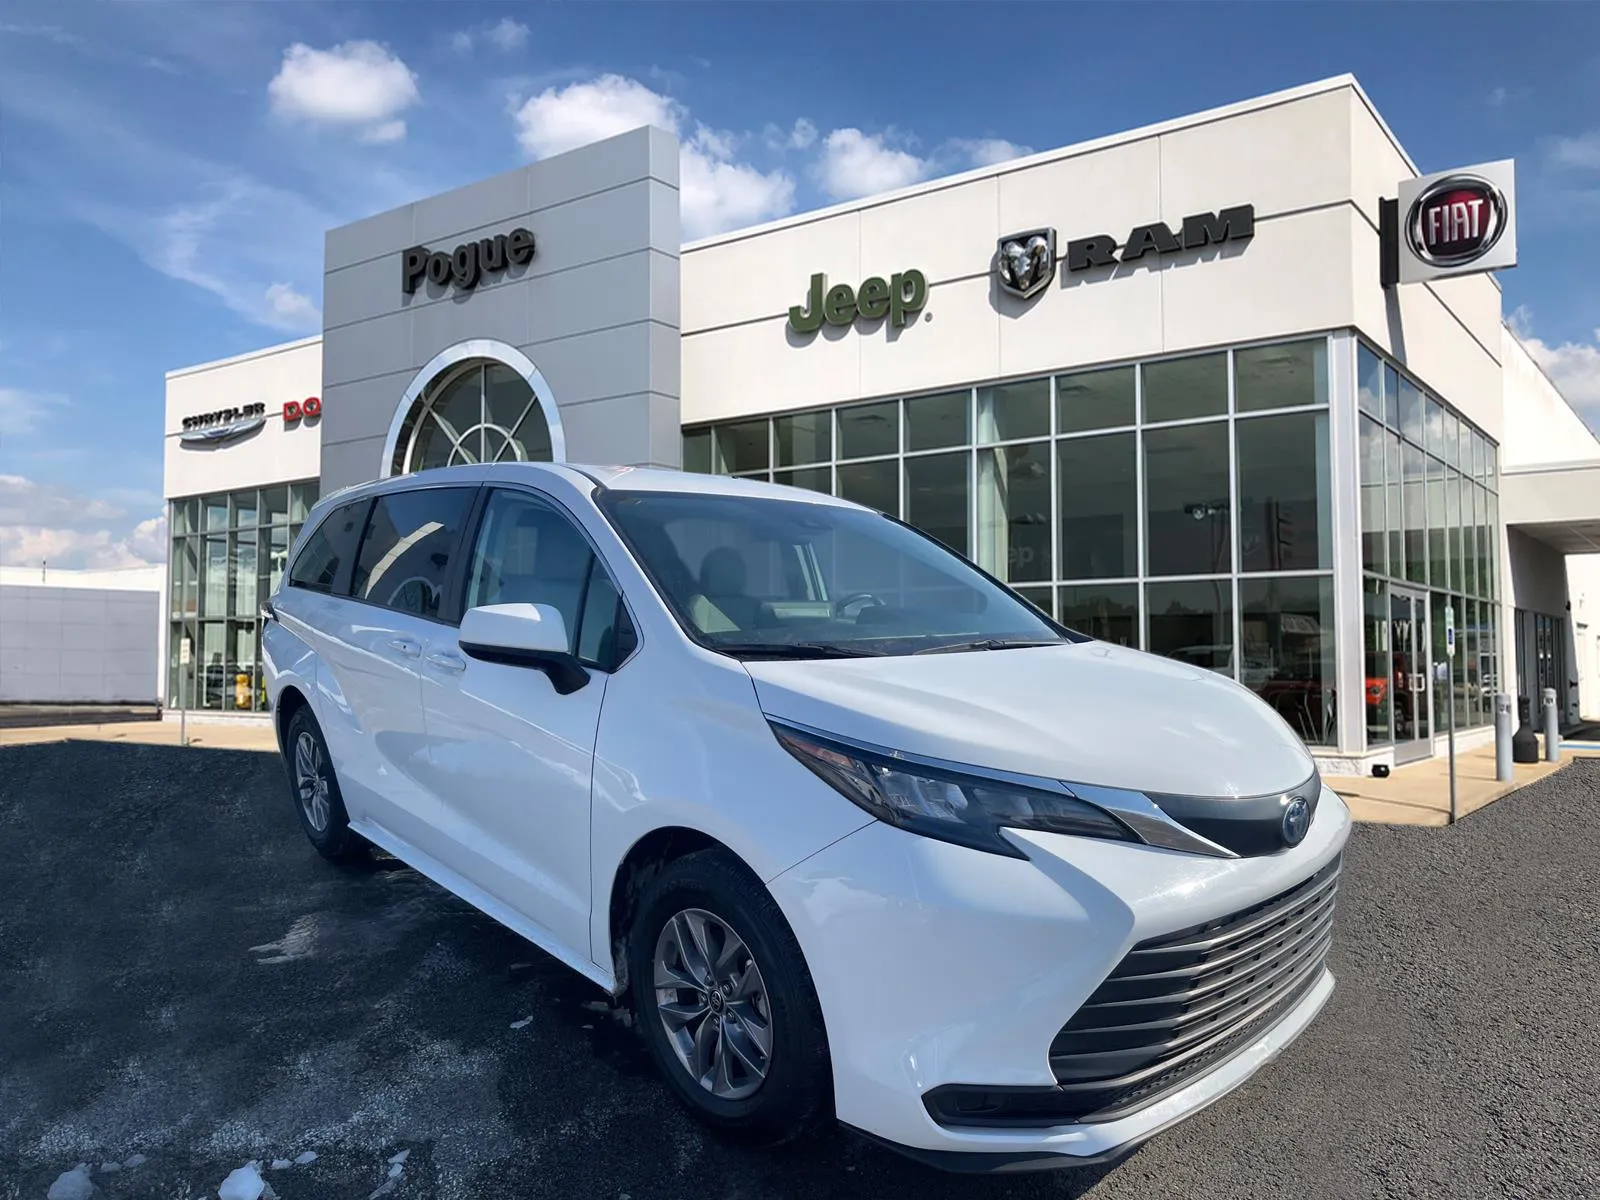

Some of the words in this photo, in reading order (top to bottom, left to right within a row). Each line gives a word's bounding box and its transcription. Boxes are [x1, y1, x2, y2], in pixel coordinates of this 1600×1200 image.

[1067, 203, 1254, 272] RAM
[1428, 199, 1484, 246] FIAT
[402, 228, 535, 294] Pogue
[789, 269, 929, 333] Jeep
